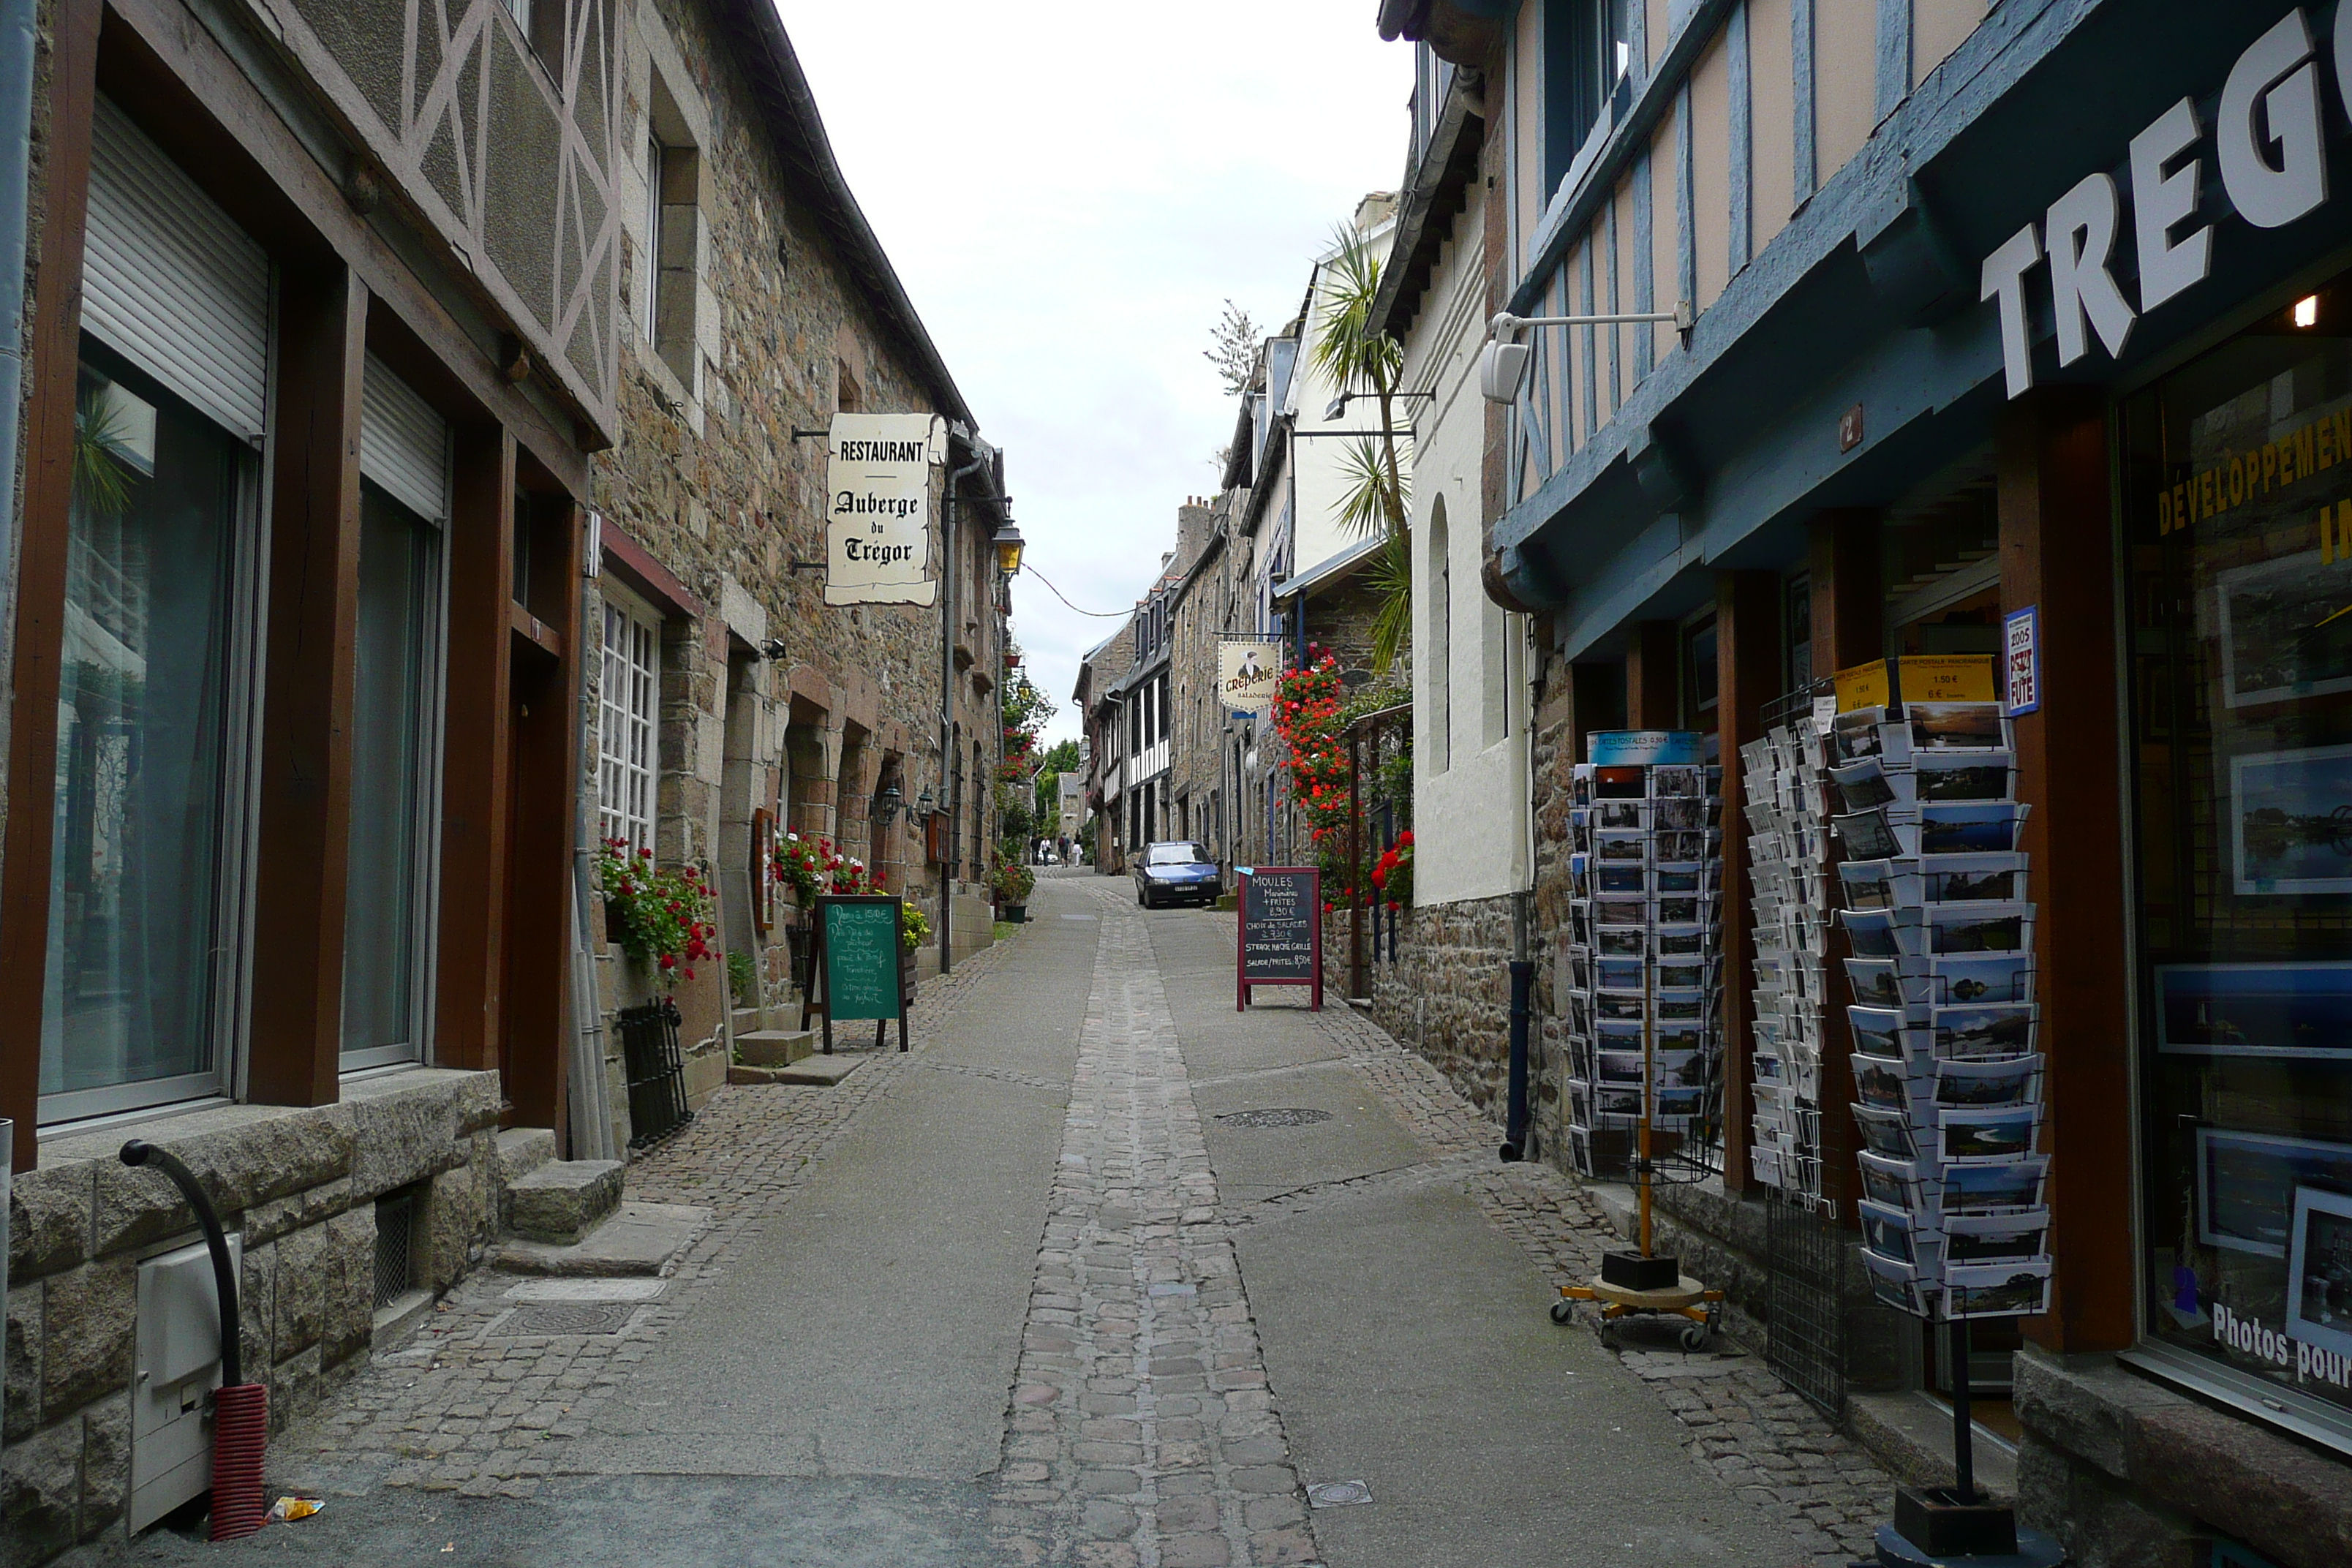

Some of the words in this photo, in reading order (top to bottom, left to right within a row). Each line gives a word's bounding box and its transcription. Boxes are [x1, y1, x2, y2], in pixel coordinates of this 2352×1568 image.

[1980, 0, 2352, 400] TREG
[1845, 415, 1853, 442] 2
[841, 441, 924, 461] RESTAURANT
[834, 491, 918, 520] Auberge
[871, 521, 883, 534] du
[845, 538, 913, 568] Trégor
[2011, 627, 2029, 647] 2005
[1952, 675, 1958, 683] €
[1252, 876, 1293, 887] MOULES
[1245, 921, 1266, 930] CHOIX
[1277, 920, 1308, 929] SALADES
[2213, 1302, 2288, 1365] Photos
[2297, 1341, 2352, 1388] pour
